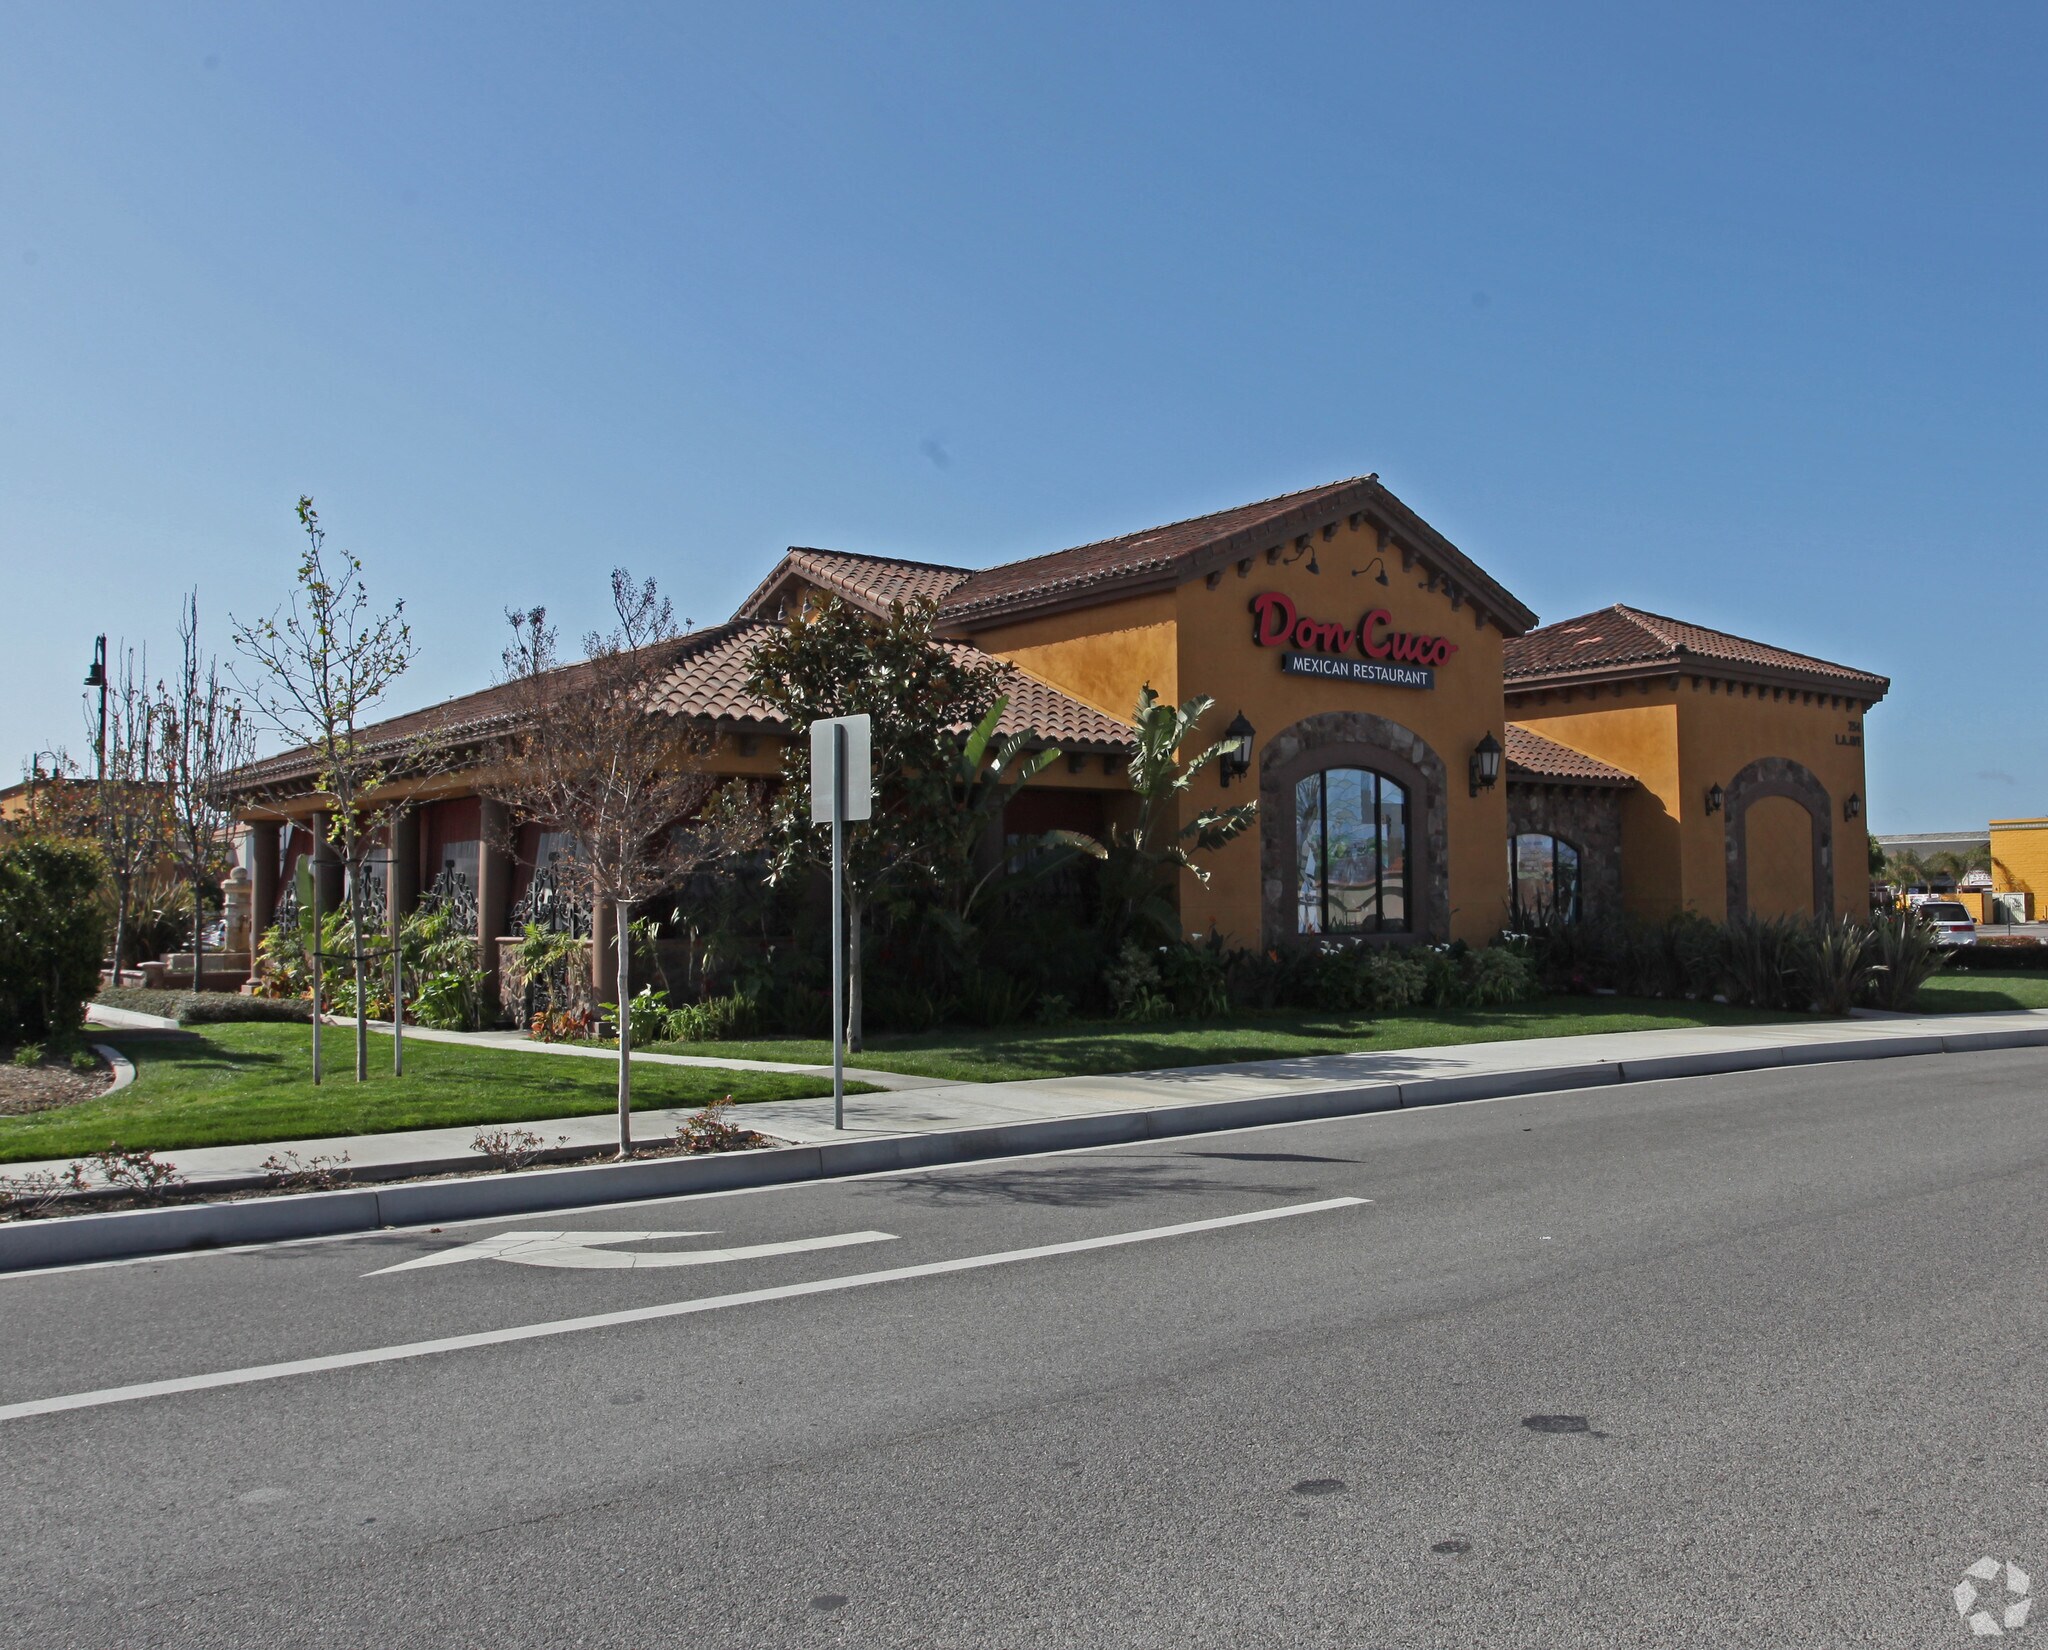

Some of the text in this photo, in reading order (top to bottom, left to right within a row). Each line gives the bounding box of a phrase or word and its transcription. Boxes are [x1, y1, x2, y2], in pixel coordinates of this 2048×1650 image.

[1253, 591, 1459, 666] Don Cuco
[1293, 657, 1428, 685] MEXICAN RESTAURANT
